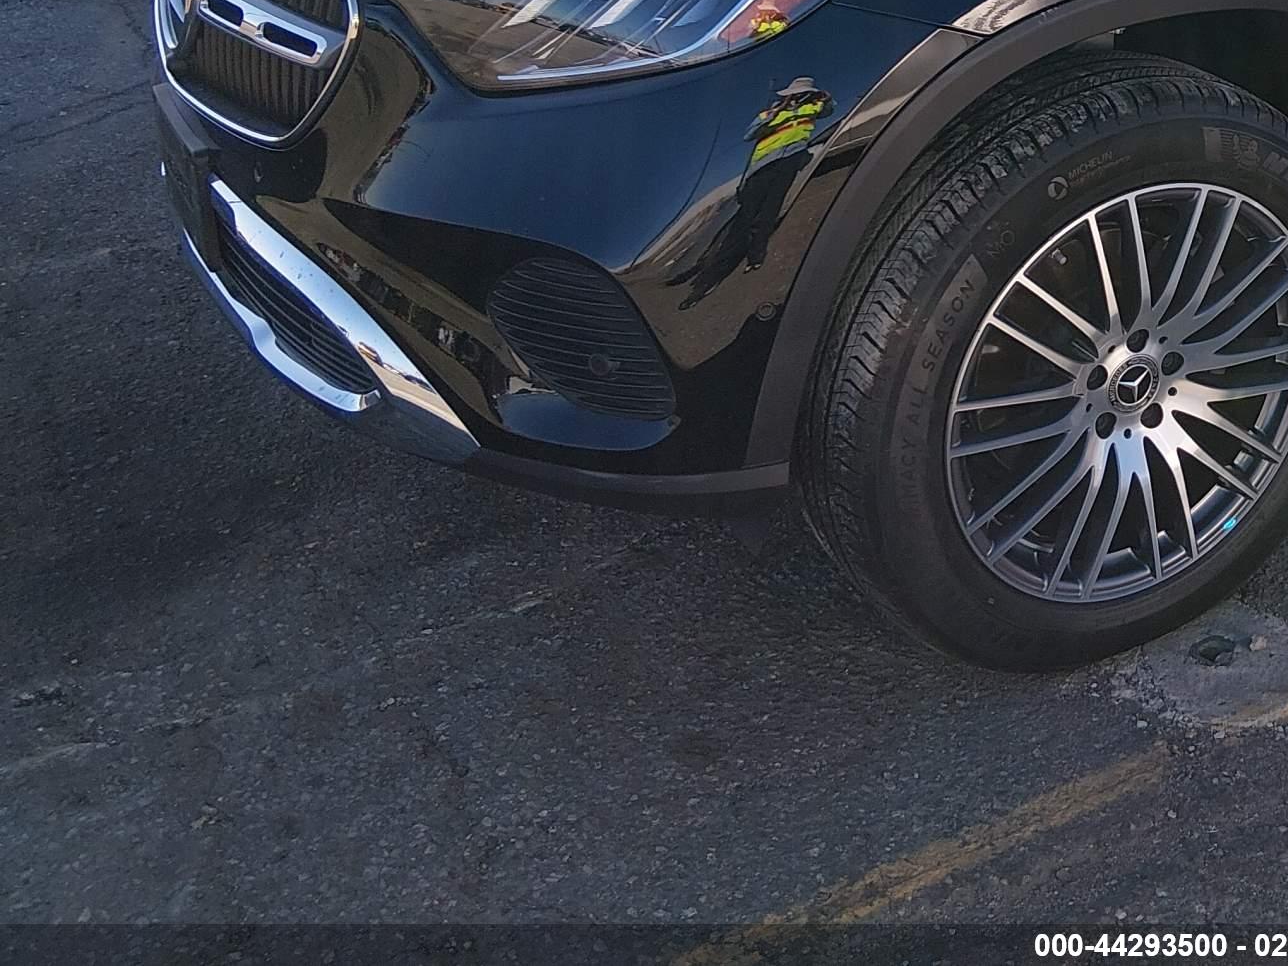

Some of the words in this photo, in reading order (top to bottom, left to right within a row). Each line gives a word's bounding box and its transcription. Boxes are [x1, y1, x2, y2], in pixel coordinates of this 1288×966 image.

[1069, 150, 1113, 180] MICHELIN
[906, 387, 928, 425] ALL
[921, 278, 976, 373] SEASON
